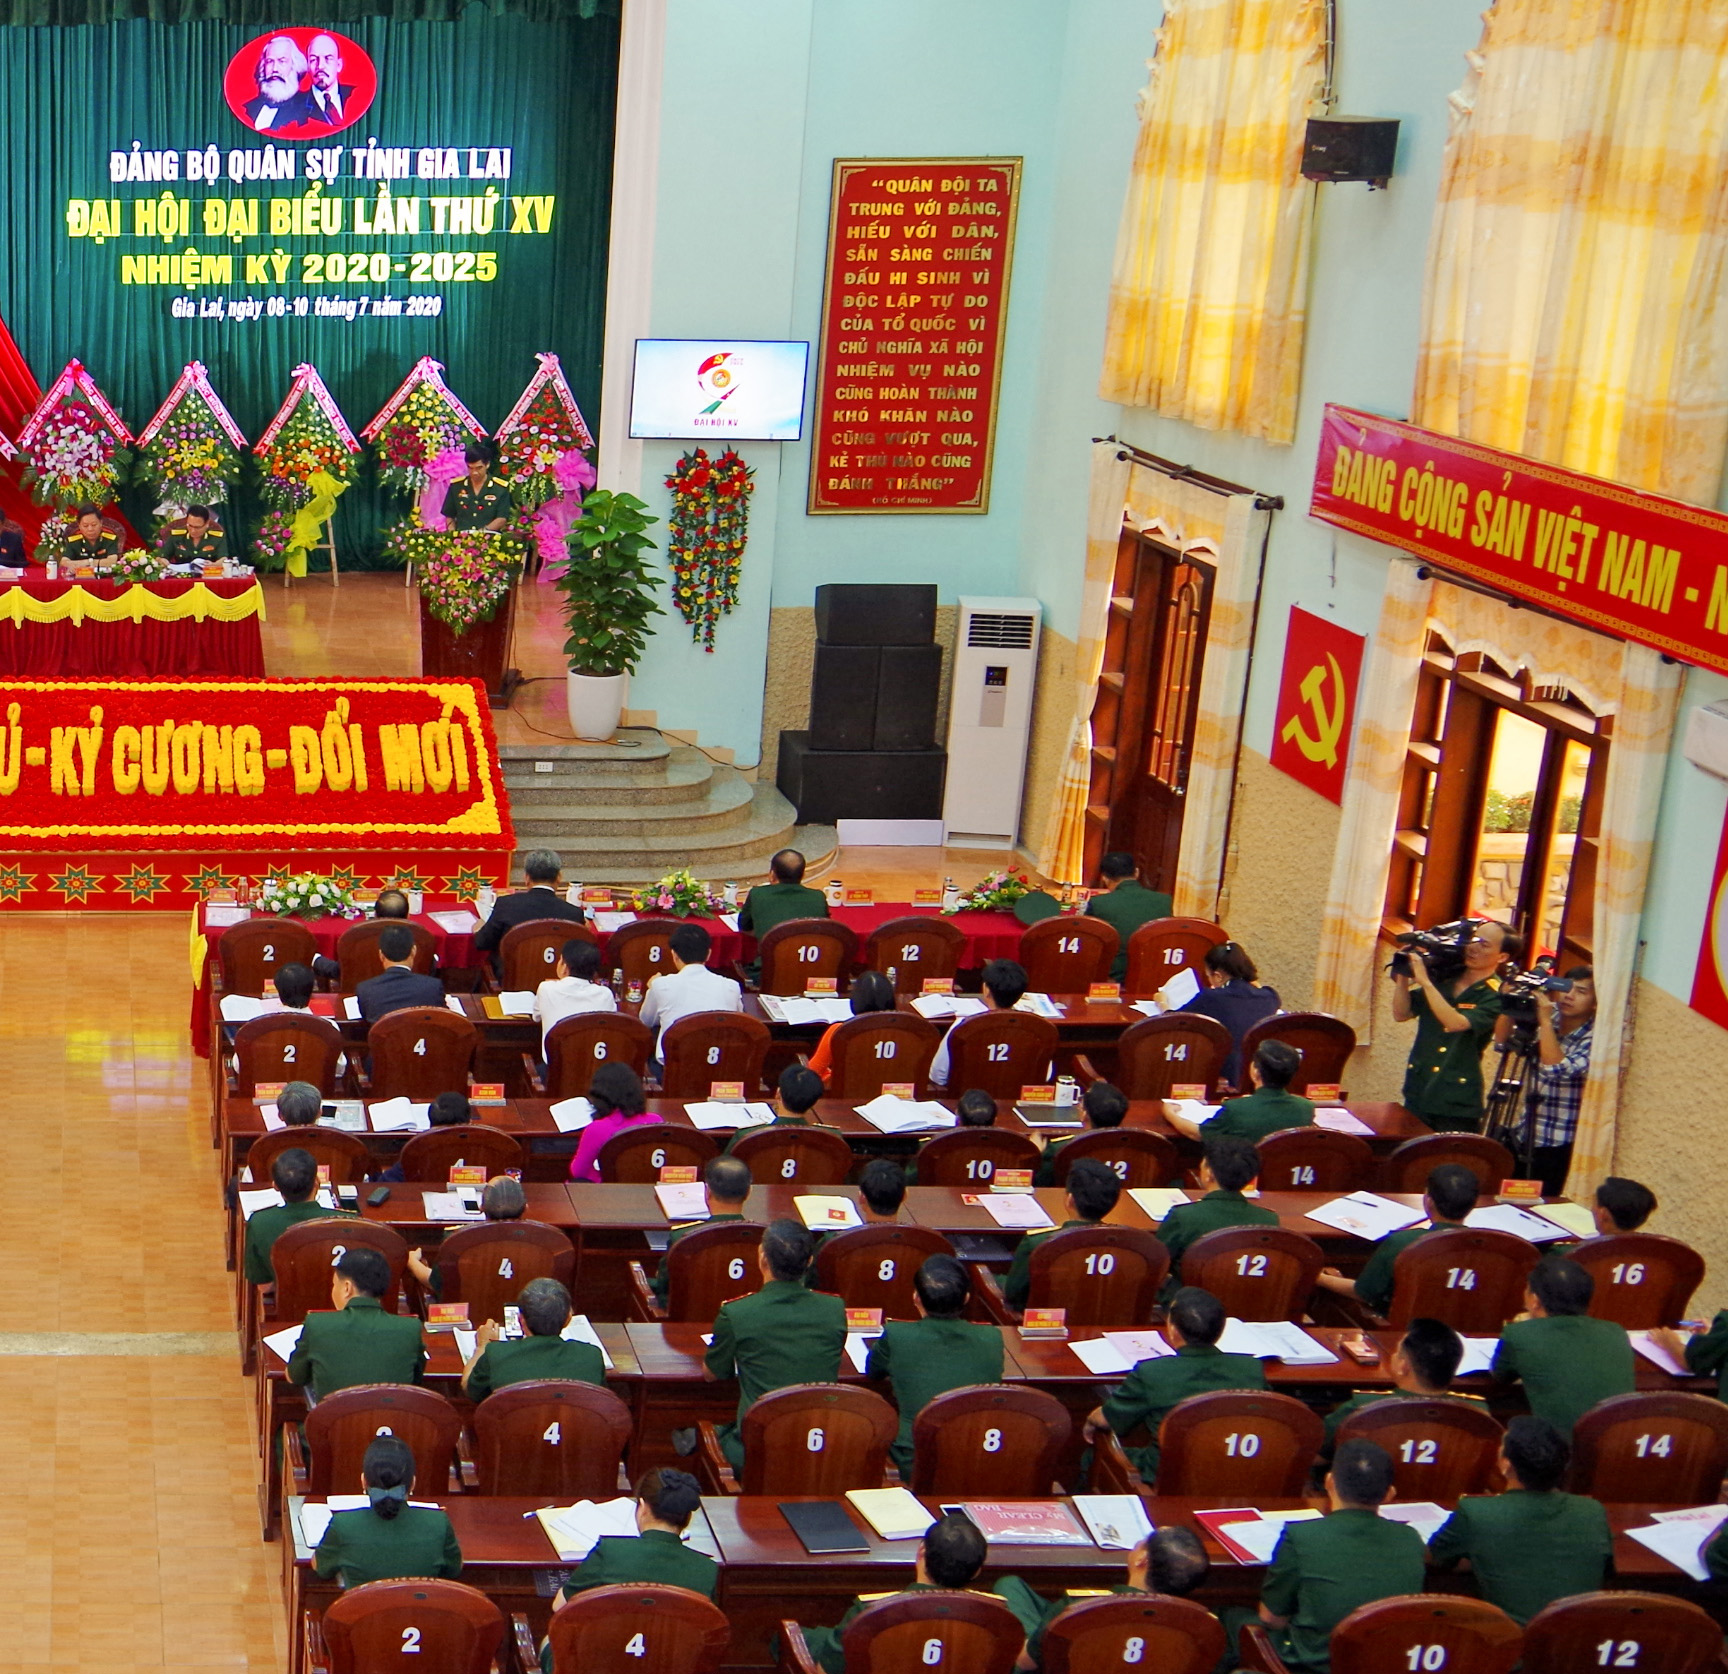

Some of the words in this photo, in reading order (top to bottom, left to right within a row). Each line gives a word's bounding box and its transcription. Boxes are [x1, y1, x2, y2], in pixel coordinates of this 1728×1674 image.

[110, 140, 179, 183] ĐẢNG
[186, 144, 221, 186] BỘ
[228, 144, 295, 182] QUÂN
[305, 145, 344, 185] SỰ
[352, 136, 409, 180] TỈNH
[417, 147, 459, 180] GIA
[469, 147, 511, 180] LAI
[941, 176, 970, 195] ĐỘI
[977, 179, 998, 192] TA
[67, 199, 121, 245] ĐẠI
[135, 191, 189, 243] HỘI
[204, 199, 259, 243] ĐẠI
[270, 180, 342, 237] BIỂU
[354, 182, 419, 235] LẦN
[431, 186, 499, 235] THỨ
[510, 196, 555, 234] XV
[849, 203, 904, 215] TRUNG
[914, 199, 941, 215] VỚI
[948, 197, 1001, 216] ĐẢNG,
[847, 220, 890, 238] HIẾU
[903, 220, 937, 238] VỚI
[952, 222, 999, 239] DÂN,
[846, 244, 878, 261] SẴN
[890, 244, 933, 261] SÀNG
[943, 242, 992, 260] CHIẾN
[121, 247, 232, 290] NHIỆM
[245, 249, 292, 284] KỲ
[844, 267, 880, 284] ĐẤU
[890, 272, 907, 284] HI
[917, 272, 961, 284] SINH
[973, 268, 990, 284] VÌ
[171, 298, 195, 318] Gia
[200, 297, 225, 321] Lai,
[228, 298, 263, 322] ngày
[267, 298, 308, 316] 08-10
[314, 296, 358, 322] tháng
[359, 298, 369, 315] 7
[373, 298, 401, 316] năm
[406, 296, 441, 316] 2020
[843, 292, 878, 310] ĐỘC
[886, 292, 921, 309] LẬP
[930, 294, 954, 310] TỰ
[964, 295, 989, 307] DO
[840, 314, 873, 331] CỦA
[882, 313, 905, 331] TỔ
[910, 314, 956, 332] QUỐC
[969, 316, 986, 331] VÌ
[833, 407, 869, 422] KHÓ
[880, 407, 927, 422] KHĂN
[937, 407, 973, 422] NÀO
[1331, 428, 1395, 514] ĐẢNG
[1399, 459, 1468, 540] CỘNG
[1471, 470, 1532, 562] SẢN
[1533, 505, 1600, 593] VIỆT
[1597, 530, 1681, 615] NAM
[379, 702, 470, 794] MỚI
[263, 945, 274, 961] 2
[798, 946, 818, 962] 10
[414, 1039, 425, 1055] 4
[707, 1047, 719, 1064] 8
[875, 1041, 895, 1058] 10
[1165, 1044, 1186, 1061] 14
[782, 1159, 795, 1177] 8
[499, 1258, 512, 1278] 4
[1086, 1254, 1113, 1274] 10
[1613, 1264, 1644, 1284] 16
[1225, 1433, 1258, 1457] 10
[1636, 1435, 1670, 1457] 14
[402, 1627, 420, 1652] 2
[626, 1633, 644, 1656] 4
[1407, 1645, 1444, 1670] 10
[1598, 1640, 1638, 1666] 12
